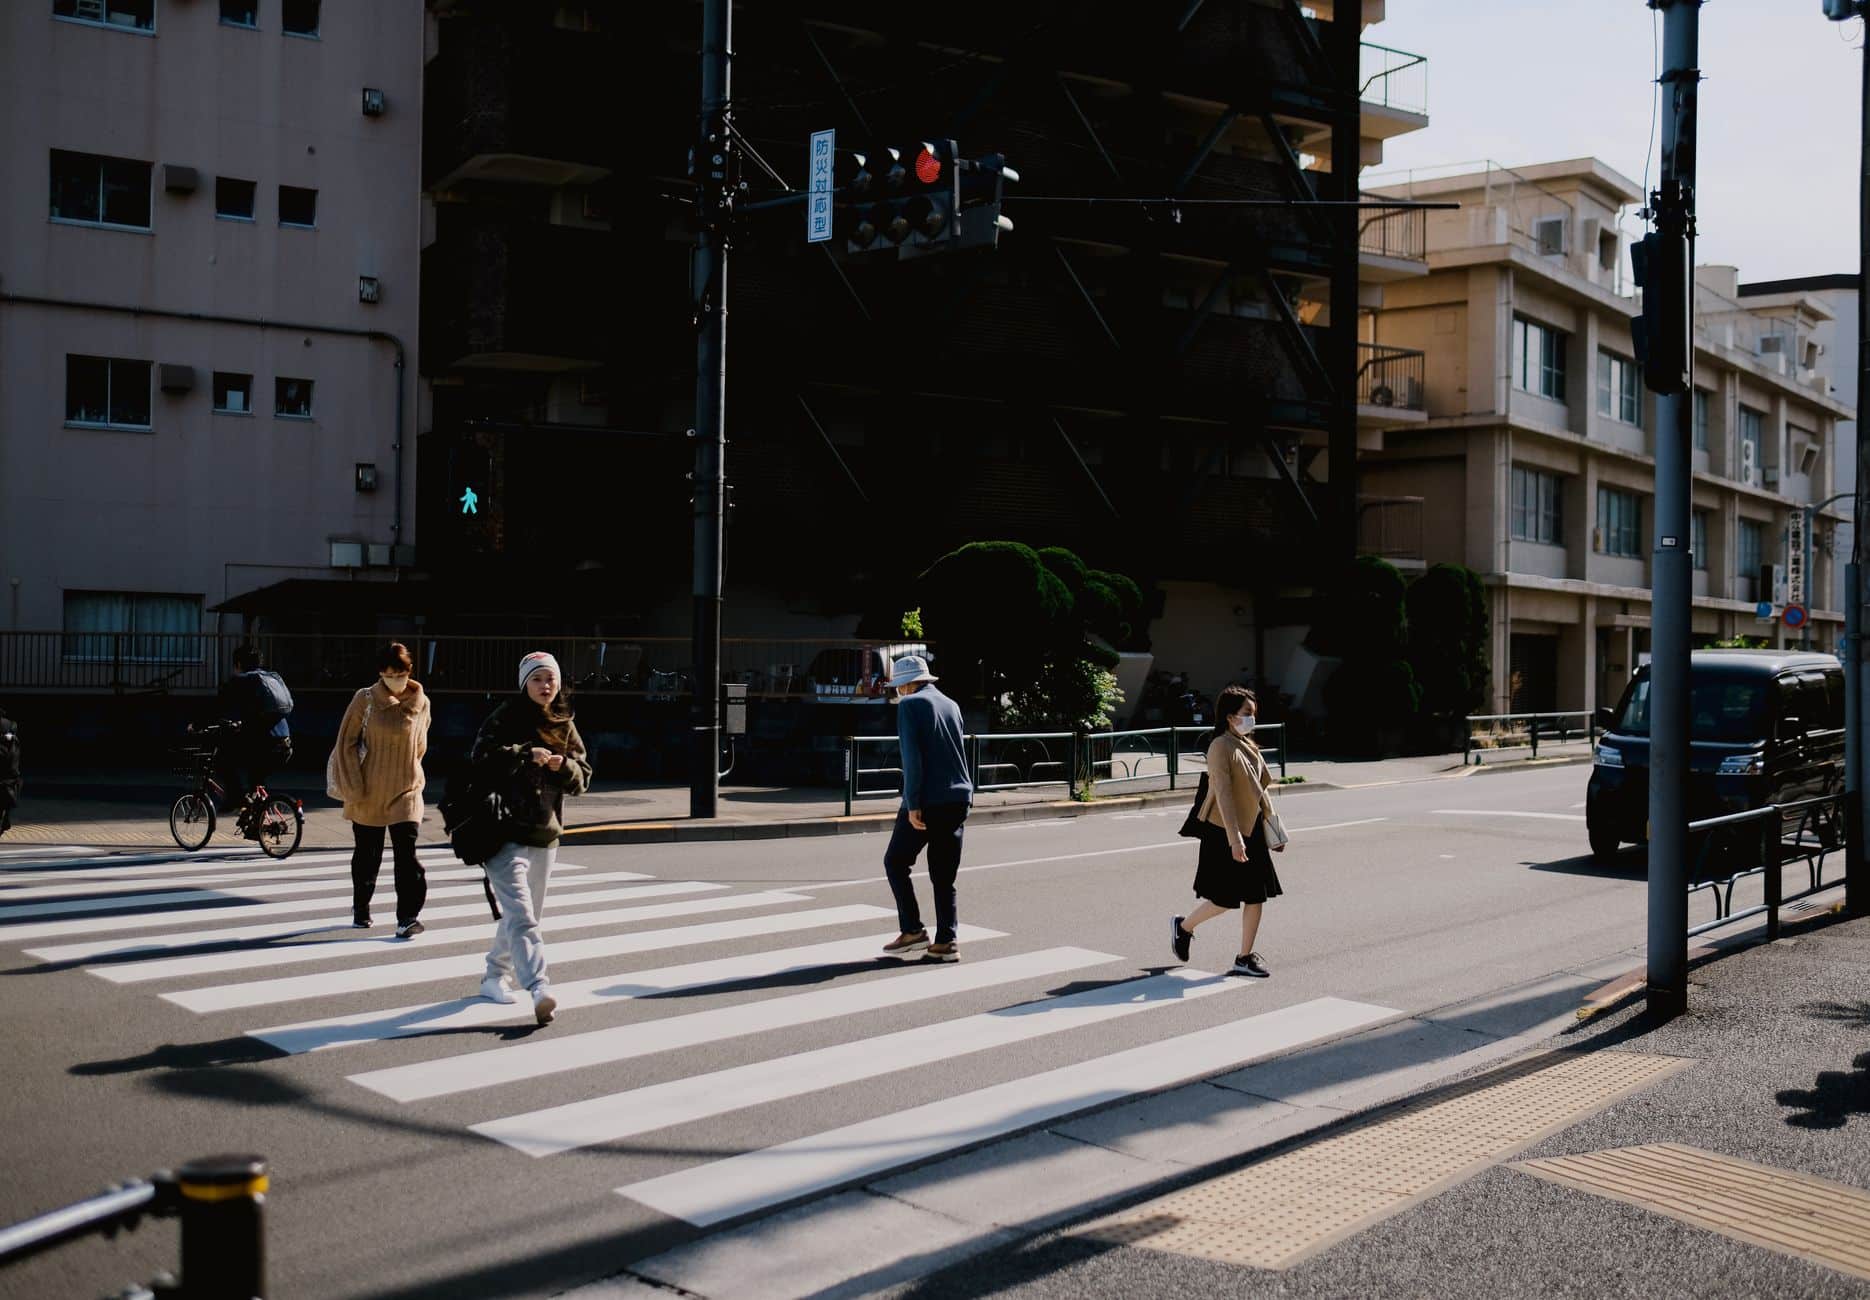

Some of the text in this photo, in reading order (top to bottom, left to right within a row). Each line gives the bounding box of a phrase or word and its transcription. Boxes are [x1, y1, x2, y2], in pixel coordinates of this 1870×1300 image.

[814, 140, 829, 233] 防災対応型
